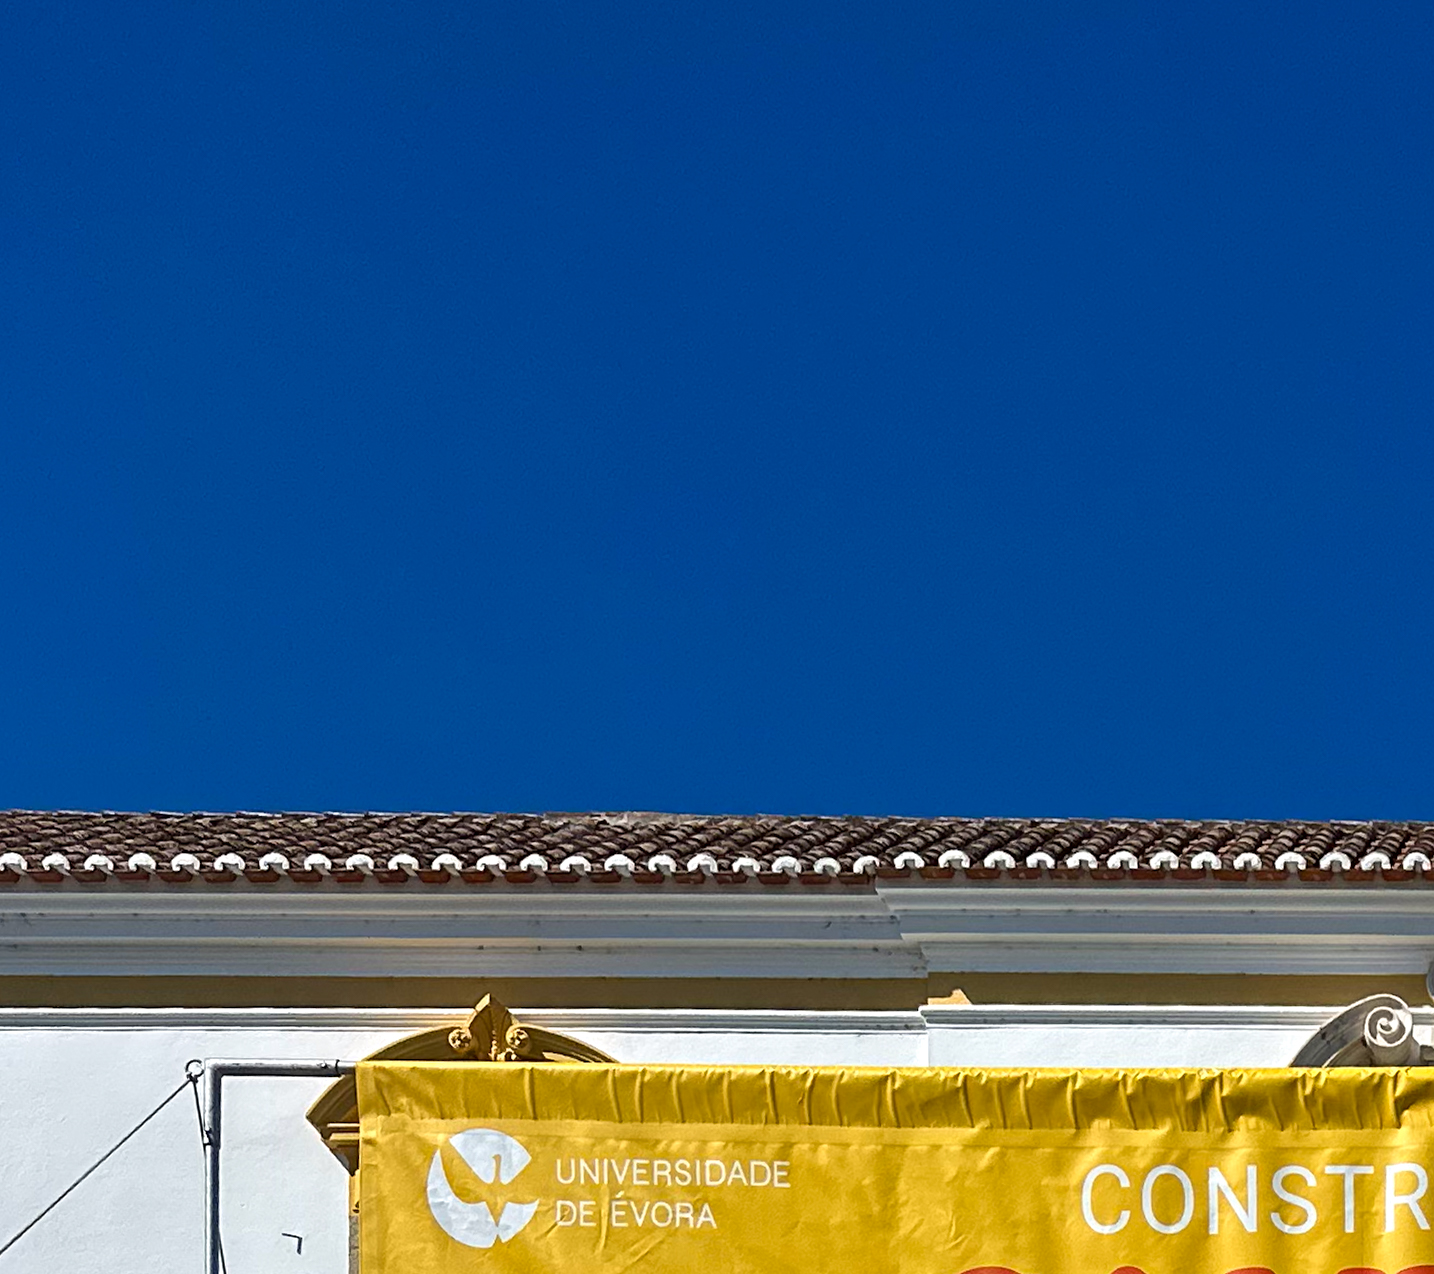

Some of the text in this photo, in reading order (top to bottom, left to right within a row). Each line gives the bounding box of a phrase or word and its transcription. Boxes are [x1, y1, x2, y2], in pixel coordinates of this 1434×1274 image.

[555, 1158, 792, 1189] UNIVERSIDADE
[556, 1191, 718, 1230] DE ÉVORA
